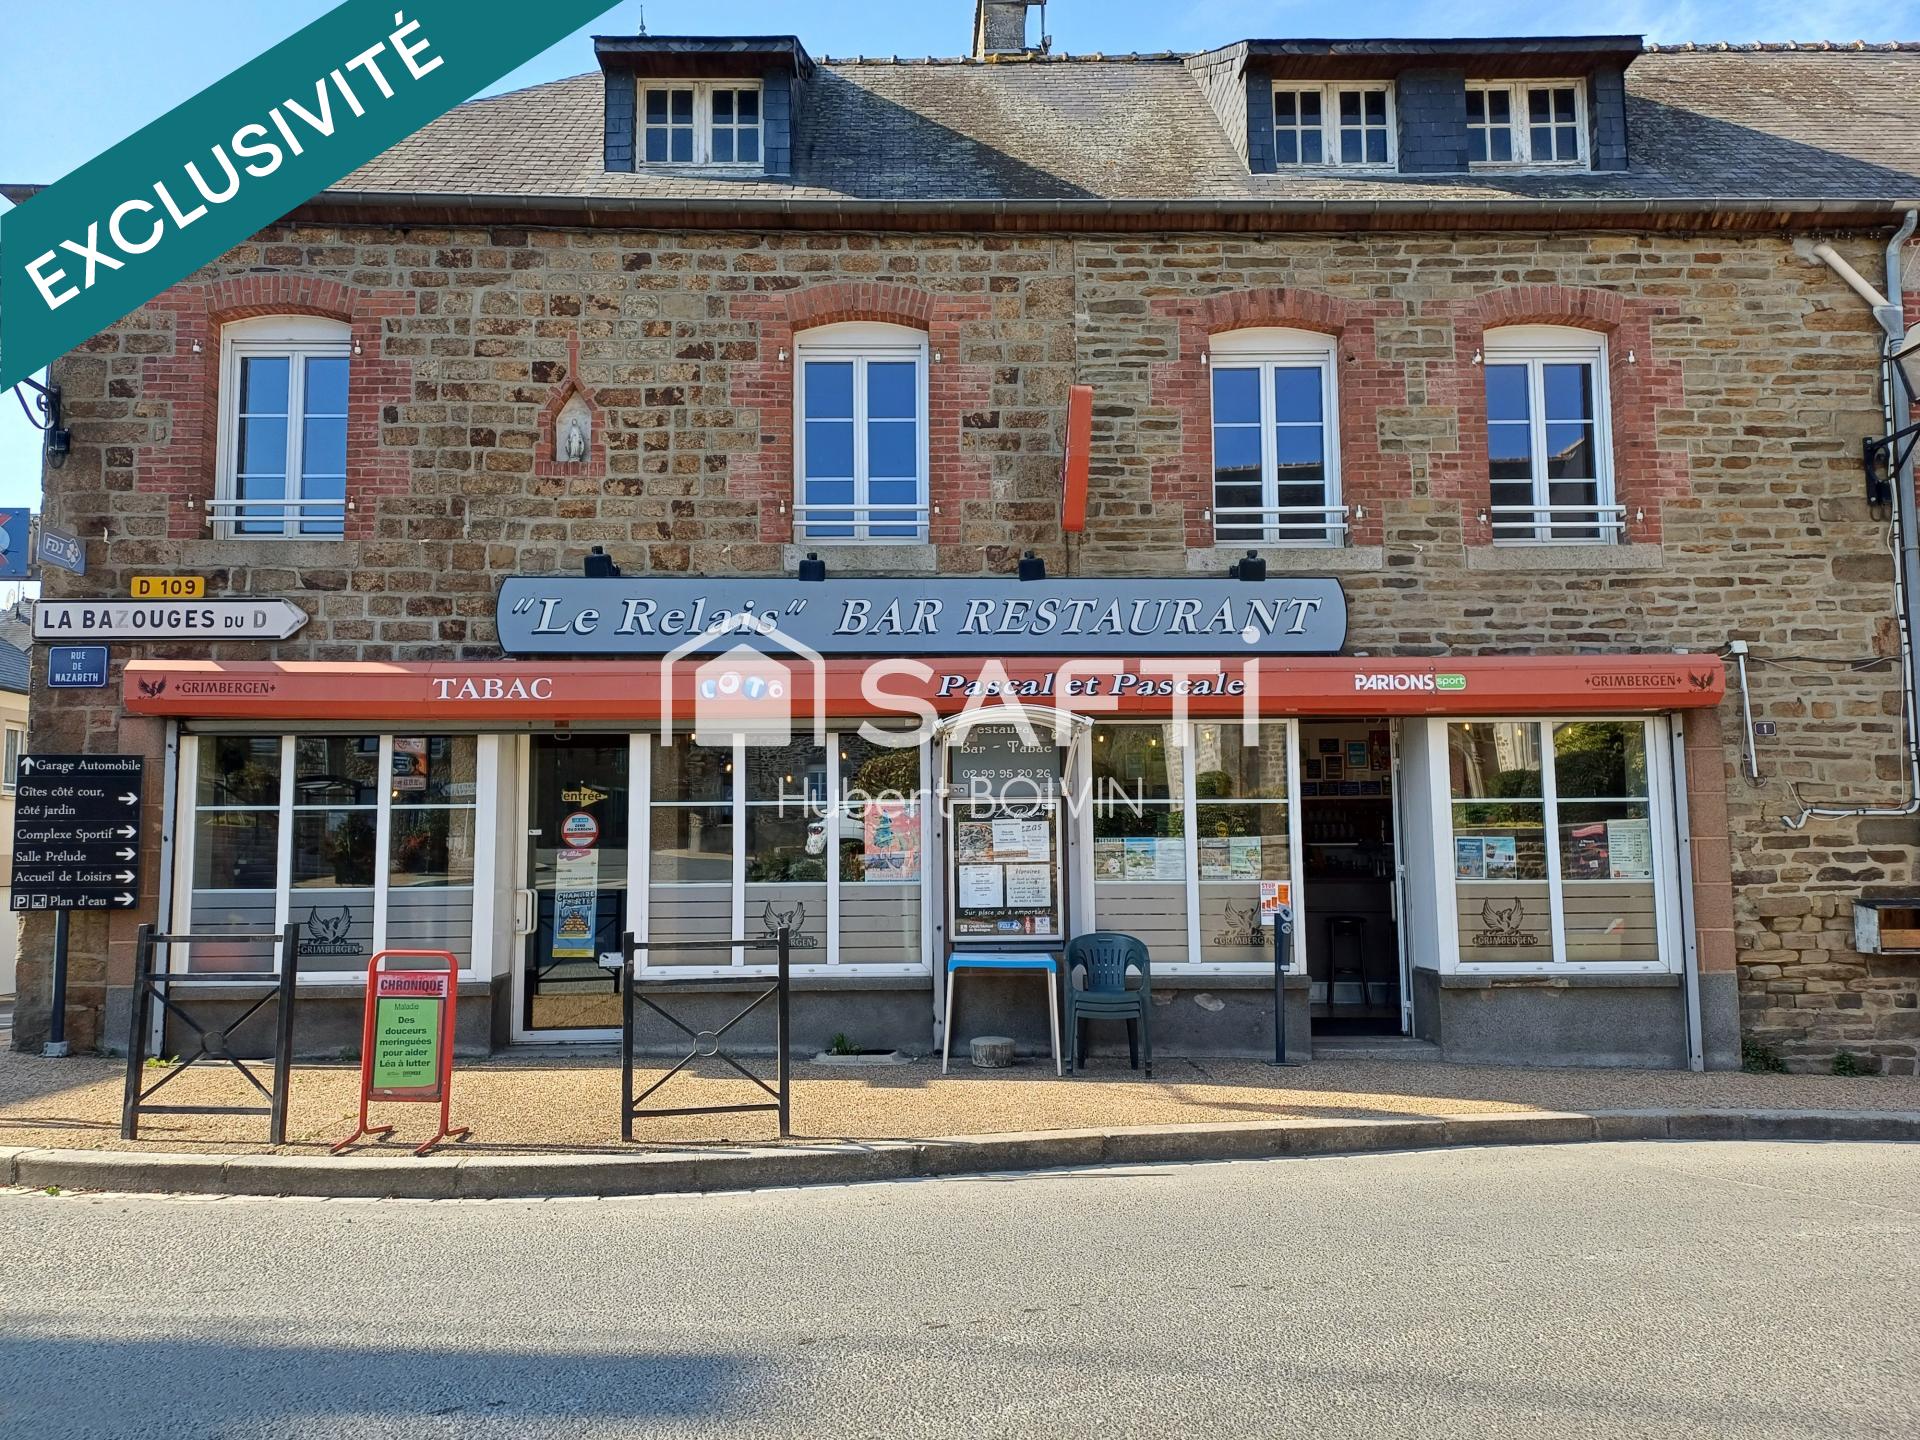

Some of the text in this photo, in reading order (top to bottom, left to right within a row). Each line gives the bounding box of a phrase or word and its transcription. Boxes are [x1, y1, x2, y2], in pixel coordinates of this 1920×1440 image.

[46, 537, 64, 554] FDJ
[139, 580, 197, 595] D 109
[44, 610, 72, 629] LA
[82, 609, 215, 629] BAZOUGES
[224, 616, 244, 629] DU
[834, 598, 945, 637] BAR
[957, 595, 1323, 637] RESTAURANT
[70, 651, 86, 660] RUE
[72, 662, 83, 671] DE
[54, 673, 99, 683] NAZARETH
[936, 671, 1246, 697] Pascal et Pascale
[1354, 673, 1466, 691] PARIONS sport
[1591, 674, 1676, 688] GRIMBERGEN
[182, 681, 269, 694] GRIMBERGEN
[432, 677, 553, 700] TABAC
[960, 741, 986, 754] Bar
[1007, 740, 1053, 754] Tabac
[36, 759, 141, 774] Garage Automobile
[962, 769, 978, 779] 02
[981, 769, 996, 779] 99
[999, 769, 1014, 779] 95
[1017, 768, 1033, 778] 20
[19, 785, 105, 798] Gîtes côté cour,
[563, 790, 602, 801] entrée
[18, 804, 76, 818] côté jardin
[17, 827, 114, 843] Complexe Sportif
[16, 850, 87, 862] Salle Prélude
[14, 870, 112, 882] Accueil de Loisirs
[49, 895, 74, 907] Plan
[77, 894, 107, 907] d'eau
[1477, 935, 1534, 945] GRIMBERGEN
[300, 945, 359, 954] GRIMBERGEN
[380, 978, 444, 992] CHRONIQUE
[398, 1016, 415, 1024] Des
[385, 1027, 427, 1035] douceurs
[379, 1037, 432, 1047] meringuées
[382, 1048, 428, 1059] pour aider
[379, 1059, 431, 1068] Léa à lutter
